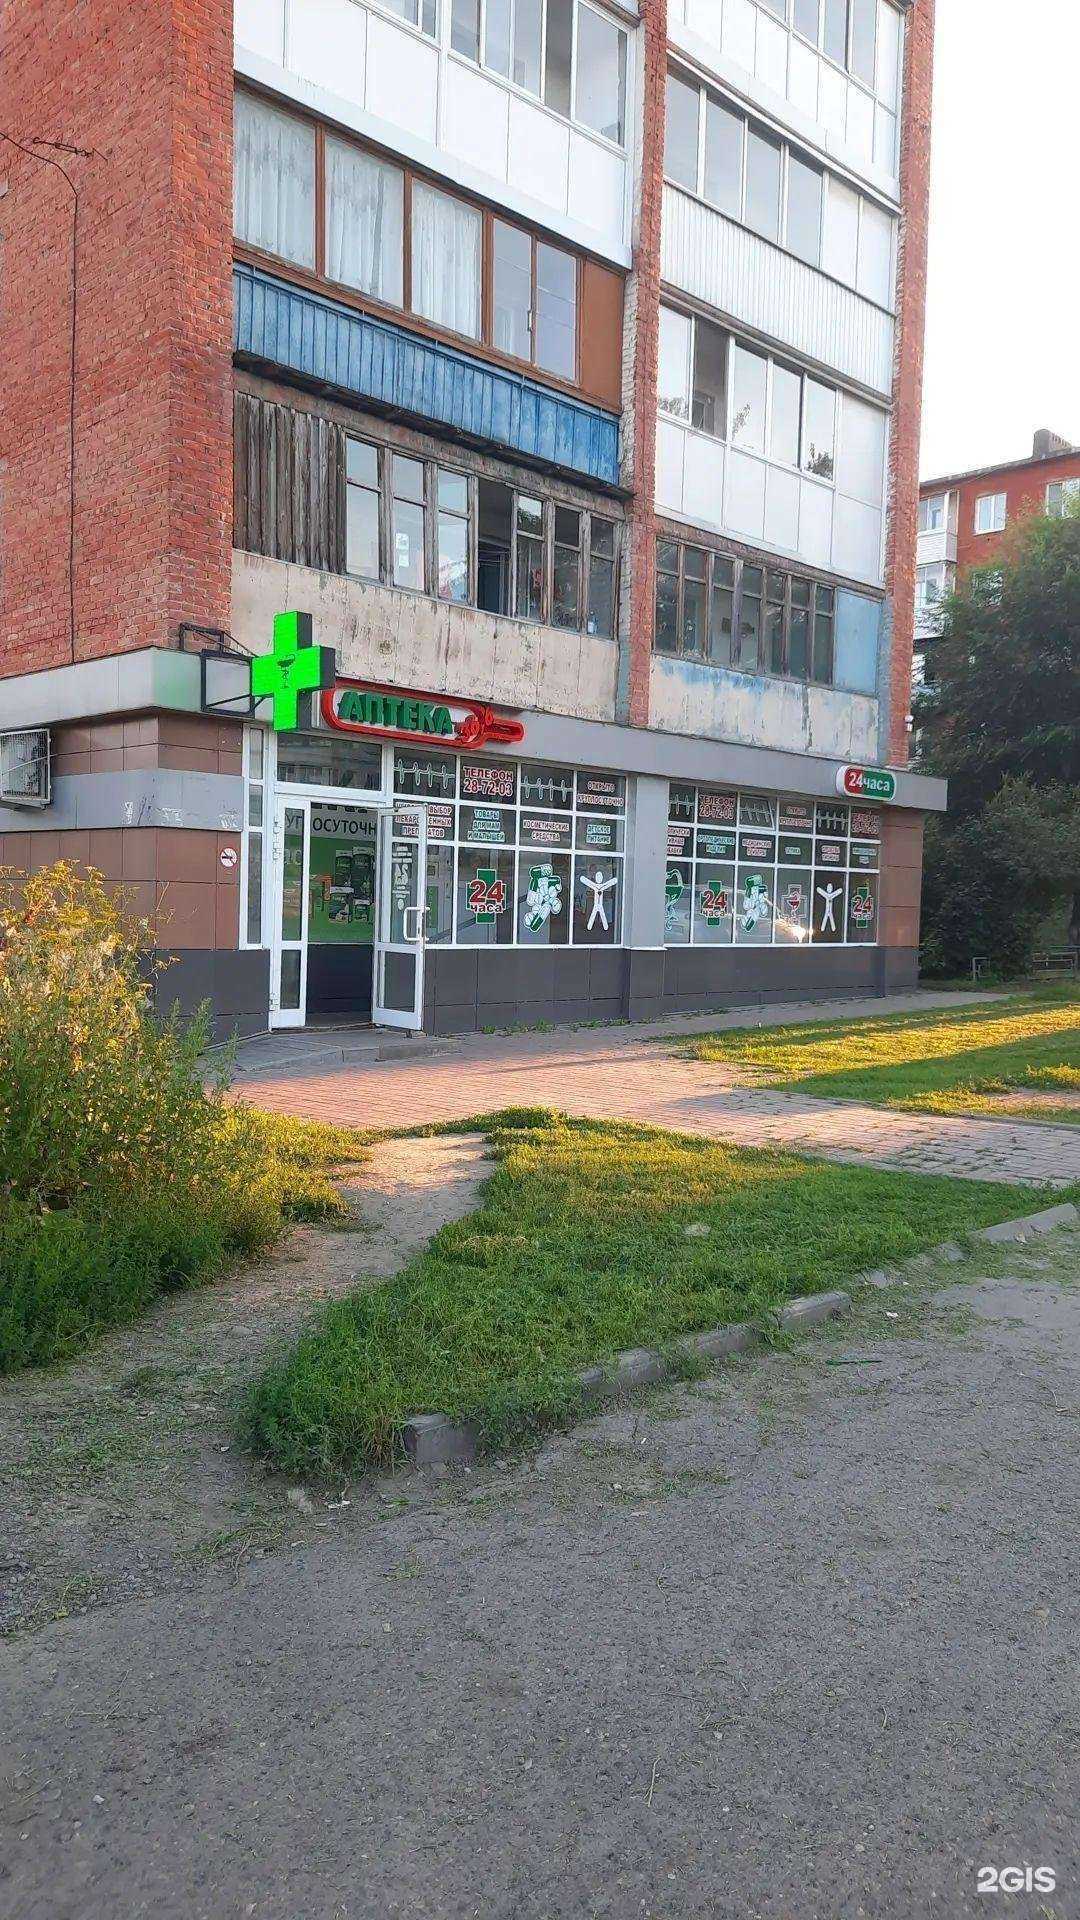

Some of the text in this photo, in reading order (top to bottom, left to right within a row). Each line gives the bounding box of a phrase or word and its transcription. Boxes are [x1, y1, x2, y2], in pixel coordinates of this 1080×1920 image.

[338, 692, 453, 735] АПТЕКА
[464, 766, 513, 782] ТЕЛЕФОН
[464, 778, 513, 796] 28-72-03
[428, 804, 452, 815] ВЫБОР
[475, 809, 500, 820] ТОВАРЫ
[523, 820, 569, 831] КОСМЕТИЧЕСКИЕ
[531, 831, 560, 841] СРЕДСТВА
[469, 880, 504, 902] 24
[702, 890, 728, 908] 24
[852, 895, 873, 913] 24
[471, 902, 503, 913] часа
[702, 907, 726, 916] часа
